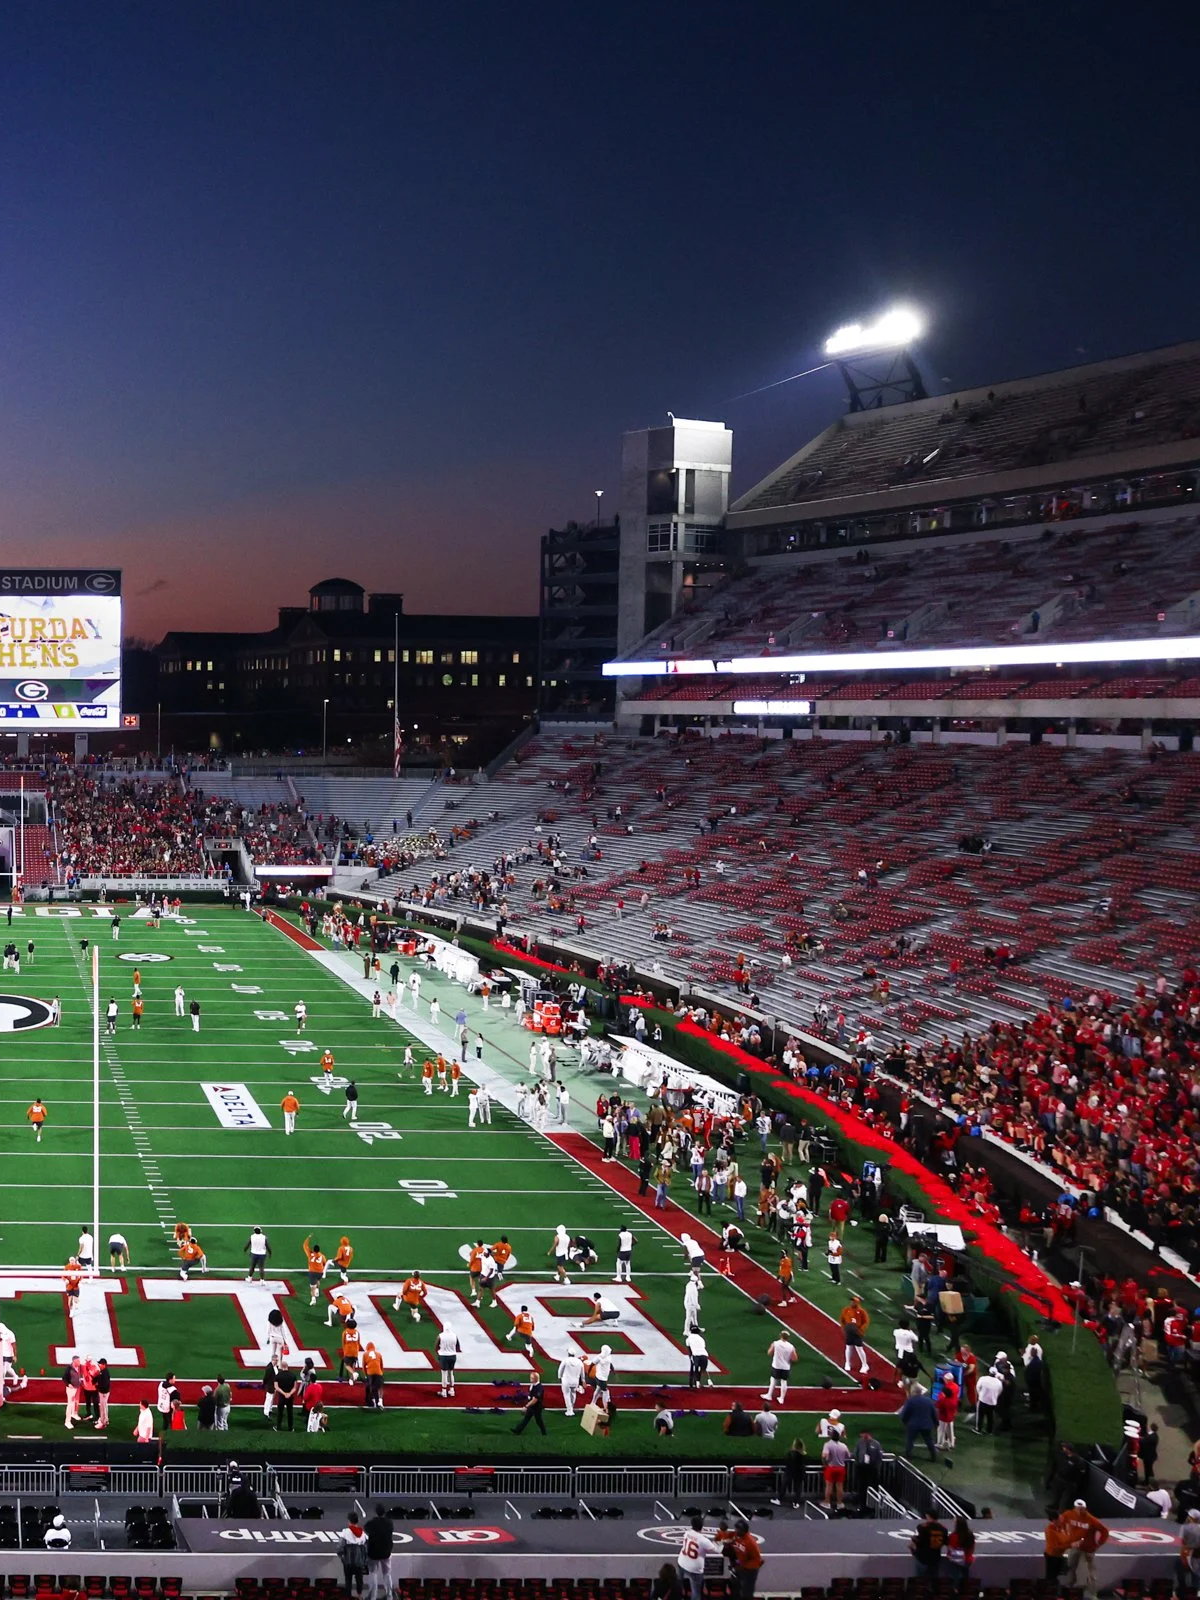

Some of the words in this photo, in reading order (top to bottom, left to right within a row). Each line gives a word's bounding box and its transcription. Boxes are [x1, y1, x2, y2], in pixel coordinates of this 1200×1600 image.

[1, 576, 78, 590] STADIUM
[17, 681, 47, 700] G
[124, 716, 136, 725] 25
[220, 1094, 256, 1126] DELTA
[349, 1121, 403, 1139] 20
[397, 1179, 458, 1198] 10
[440, 1530, 501, 1543] QT
[682, 1538, 700, 1560] 16
